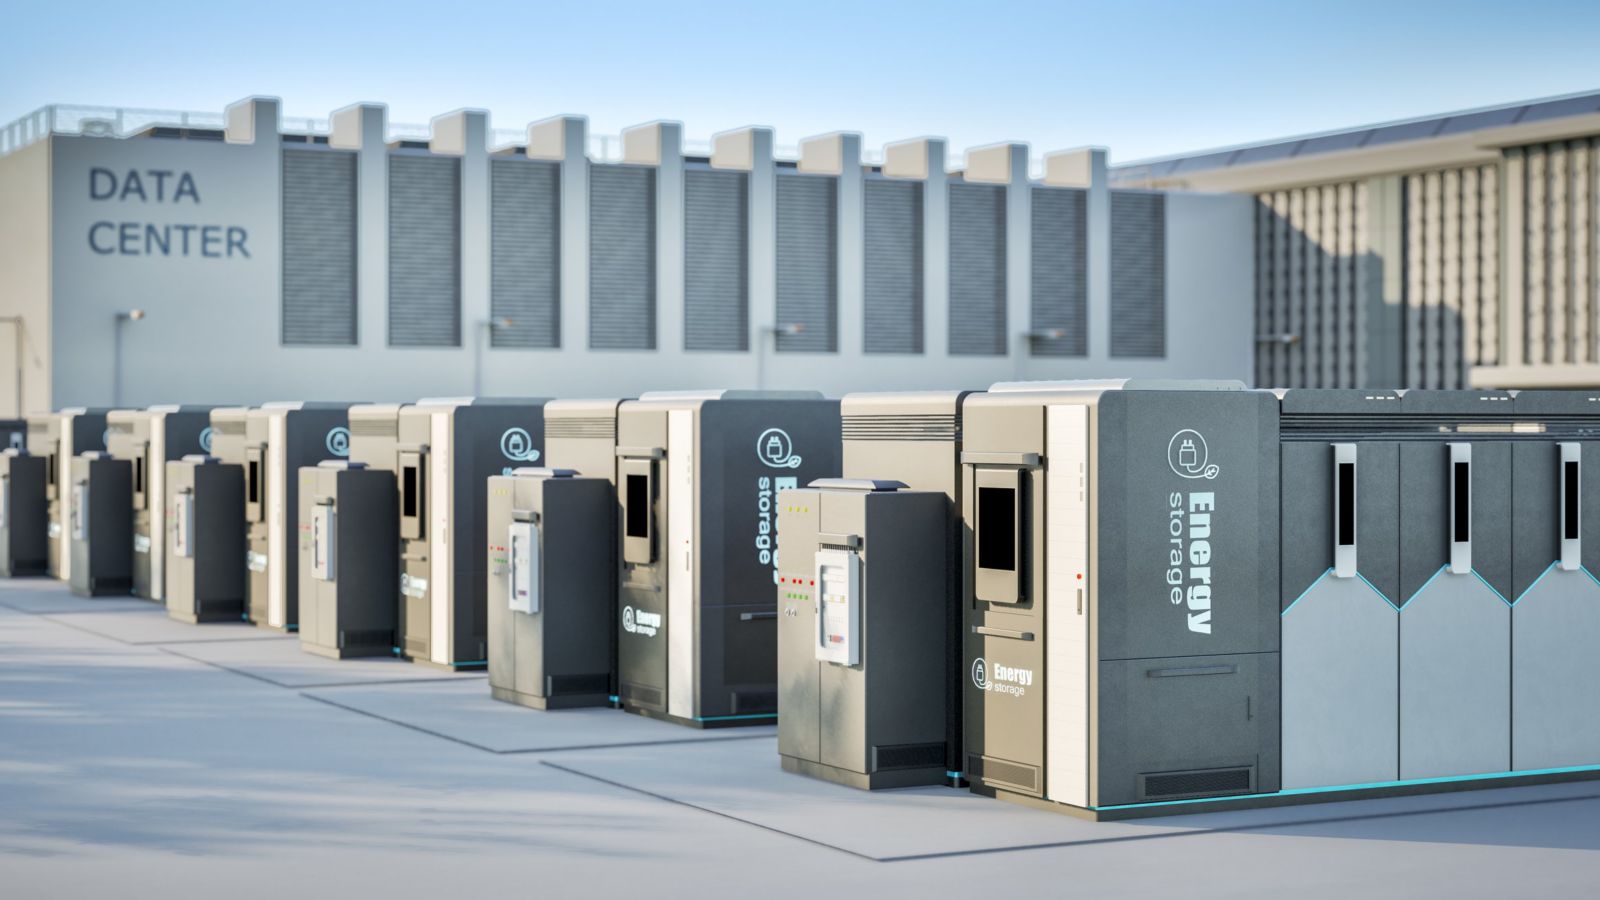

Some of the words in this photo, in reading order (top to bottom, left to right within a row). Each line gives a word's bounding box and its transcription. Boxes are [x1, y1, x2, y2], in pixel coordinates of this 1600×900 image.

[89, 167, 201, 203] DATA
[88, 221, 251, 258] CENTER
[755, 476, 772, 565] storage
[1166, 492, 1184, 605] storage
[1186, 492, 1215, 634] Energy
[994, 663, 1033, 686] Energy
[994, 683, 1025, 697] storage
